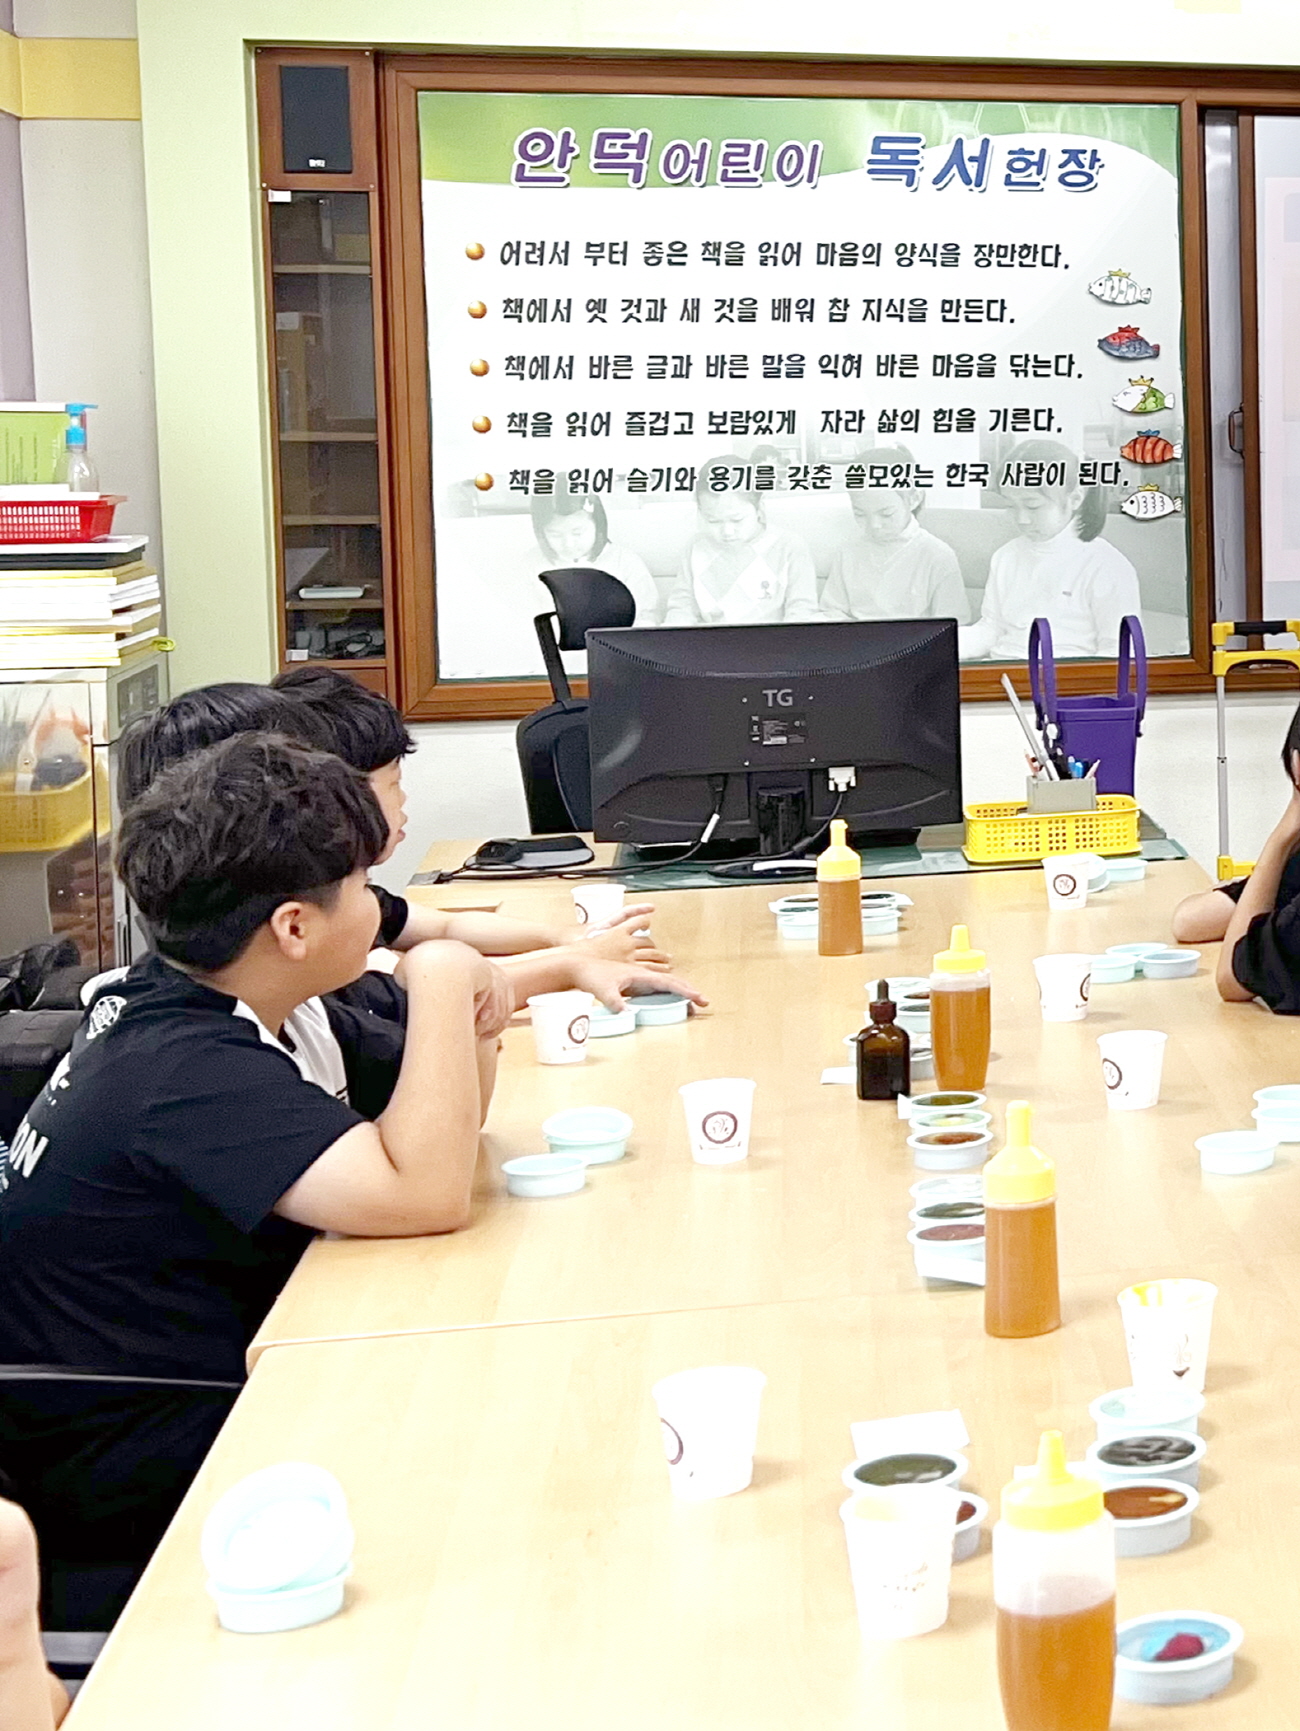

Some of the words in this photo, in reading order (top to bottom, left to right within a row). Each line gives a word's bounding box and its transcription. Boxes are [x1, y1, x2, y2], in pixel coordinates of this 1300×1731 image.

[501, 241, 569, 266] 어려서
[585, 241, 627, 266] 부터
[643, 241, 687, 266] 좋은
[702, 242, 745, 266] 책을
[759, 242, 801, 266] 읽어
[817, 243, 881, 266] 마음의
[895, 243, 960, 267] 양식을
[974, 244, 1068, 269] 장만한다.
[503, 298, 571, 323] 책에서
[586, 299, 606, 323] 옛
[621, 298, 667, 323] 것과
[680, 298, 700, 322] 새
[715, 298, 758, 322] 것을
[772, 298, 814, 322] 배워
[829, 298, 849, 322] 참
[863, 299, 927, 322] 지식을
[941, 299, 1014, 323] 만든다.
[505, 356, 573, 380] 책에서
[590, 356, 633, 379] 바른
[647, 355, 692, 379] 글과
[706, 355, 749, 378] 바른
[763, 354, 805, 378] 말을
[819, 354, 861, 378] 익혀
[877, 354, 919, 378] 바른
[933, 354, 996, 378] 마음을
[1010, 354, 1082, 378] 닦는다.
[508, 412, 552, 437] 책을
[567, 412, 610, 436] 읽어
[626, 411, 693, 436] 즐겁고
[708, 410, 795, 435] 보람있게
[821, 410, 865, 433] 자라
[878, 409, 919, 433] 삶의
[933, 408, 976, 432] 힘을
[990, 408, 1061, 432] 기른다.
[510, 470, 554, 494] 책을
[569, 469, 612, 493] 읽어
[628, 467, 696, 492] 슬기와
[710, 466, 775, 491] 용기를
[788, 465, 832, 490] 갖춘
[846, 464, 933, 488] 쓸모있는
[947, 464, 988, 487] 한국
[1002, 463, 1065, 486] 사람이
[1079, 462, 1130, 487] 된다.
[762, 688, 793, 707] TG
